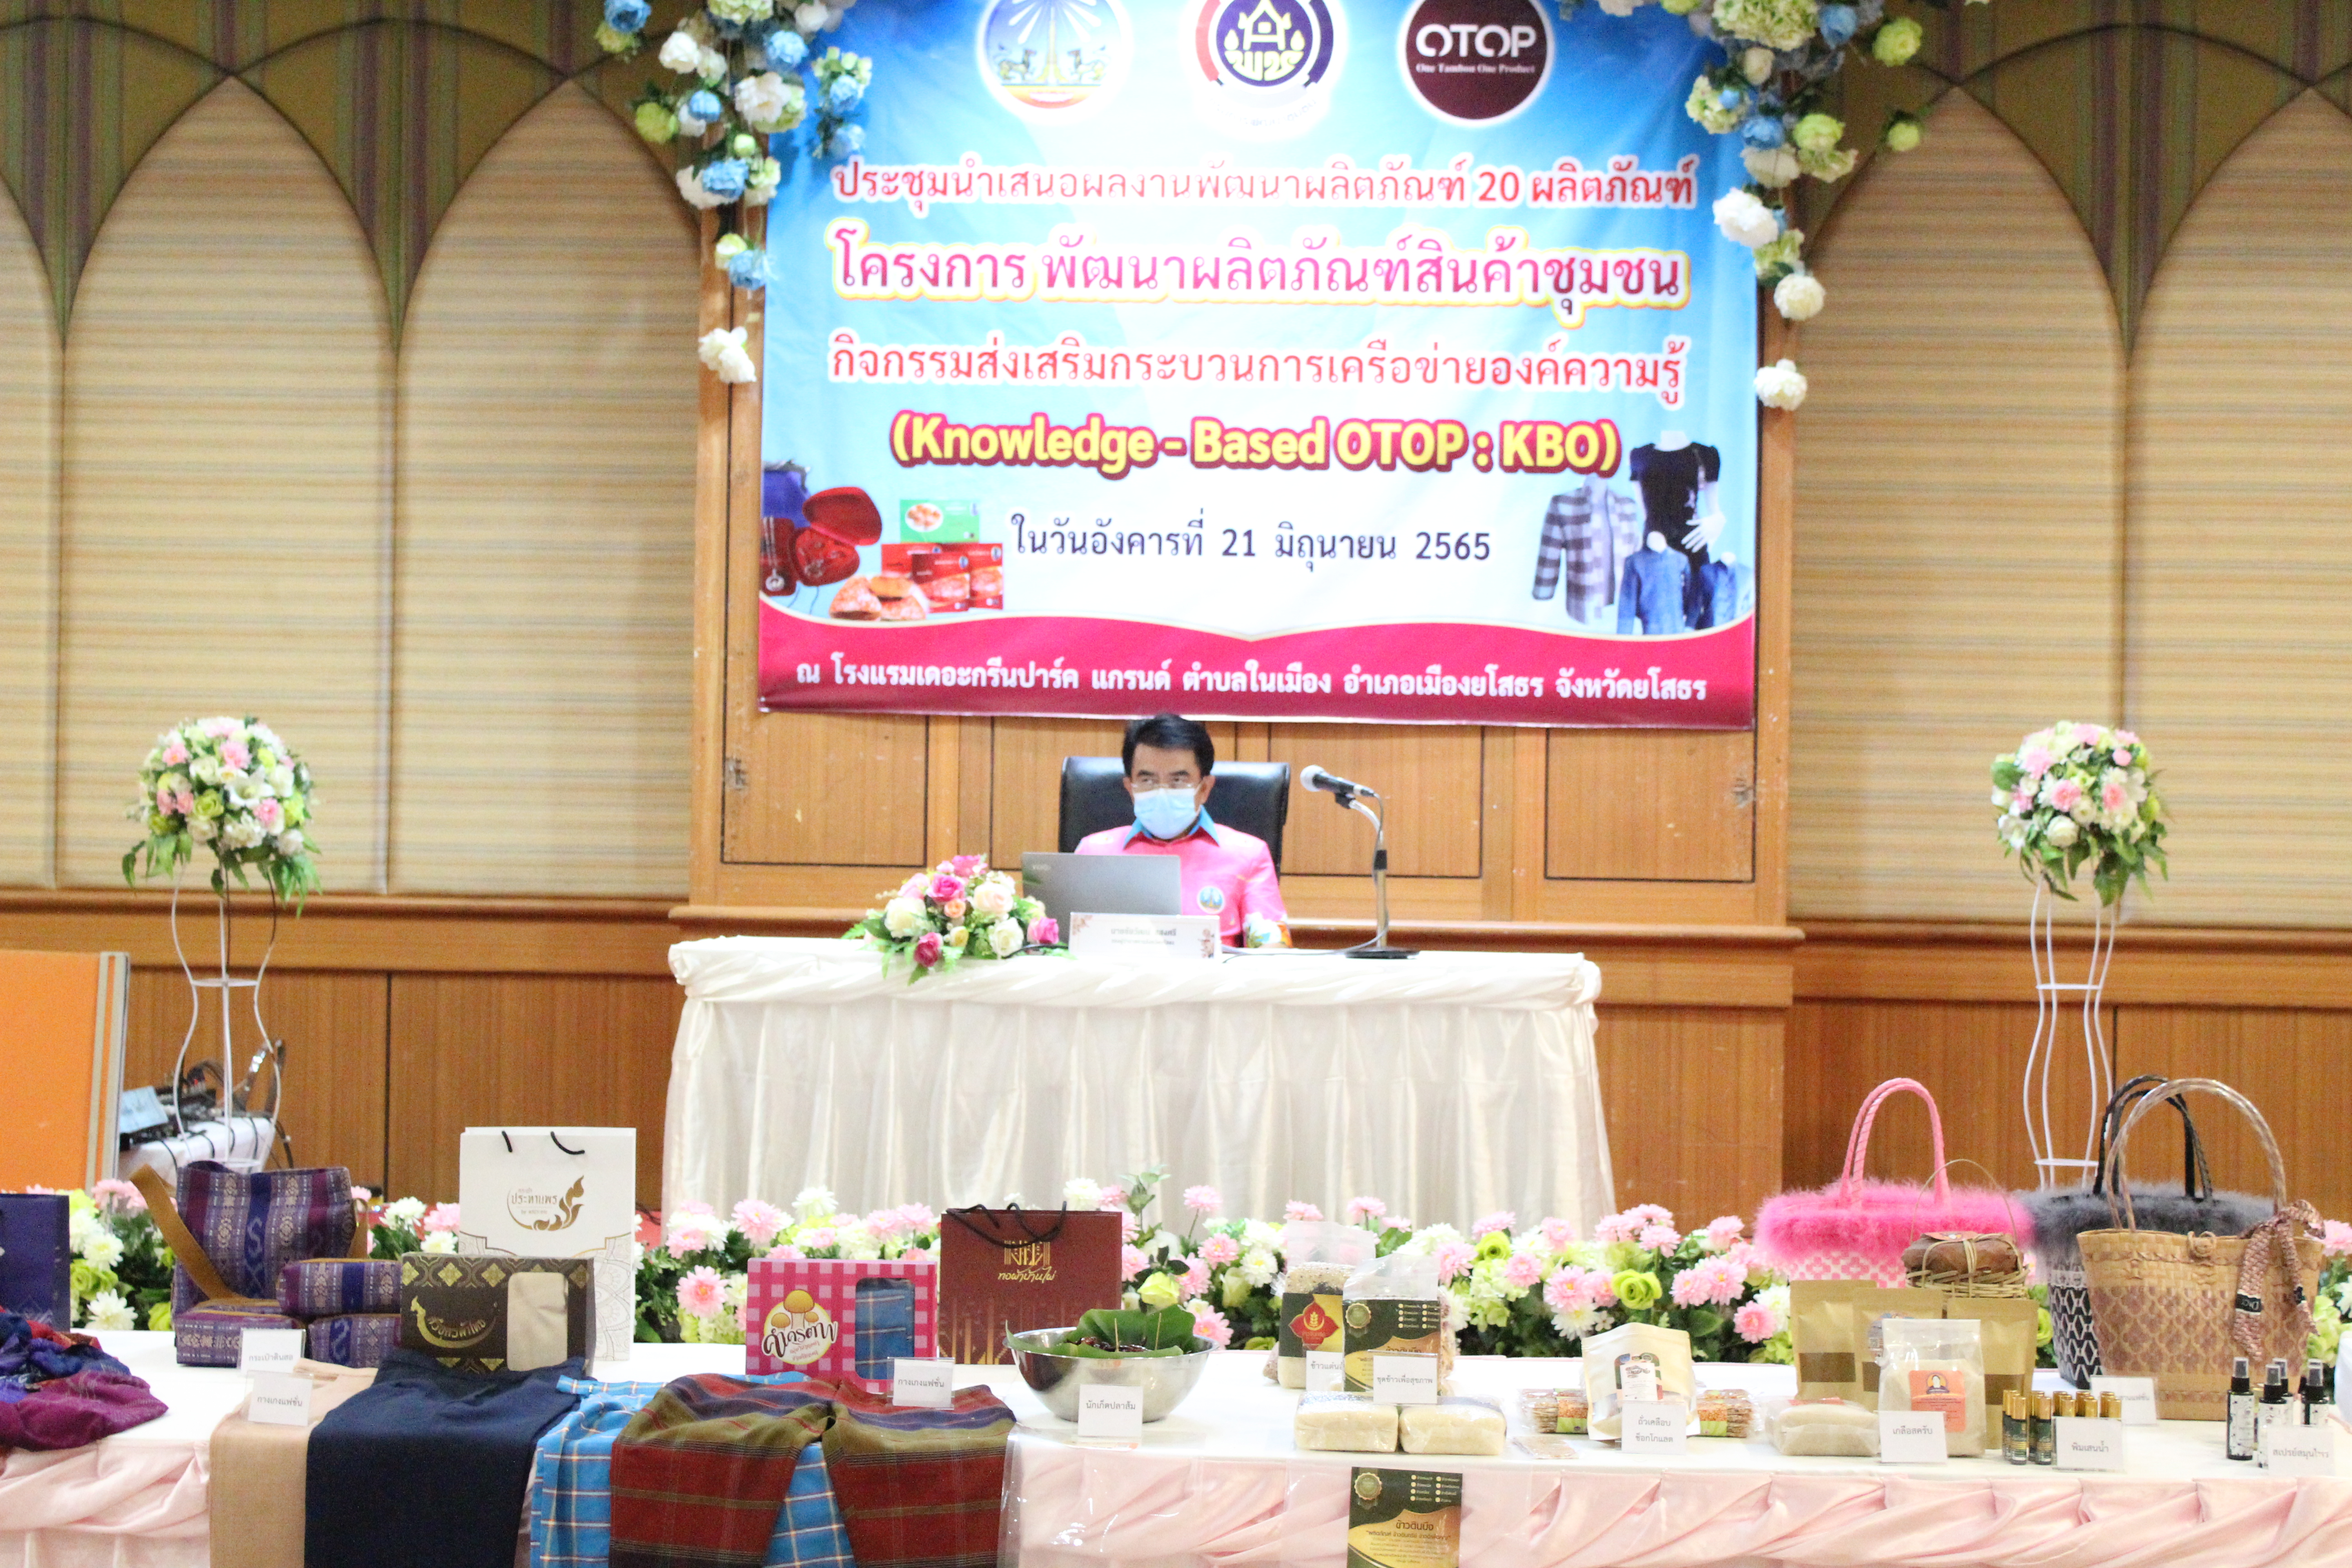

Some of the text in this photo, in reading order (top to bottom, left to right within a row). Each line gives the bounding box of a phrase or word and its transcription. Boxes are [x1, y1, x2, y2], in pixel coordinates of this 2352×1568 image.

[1416, 23, 1537, 58] OTOP
[1416, 63, 1436, 73] One
[1477, 64, 1496, 74] One
[1499, 64, 1536, 74] Product
[835, 158, 1695, 212] ประชุมนำเสนอผลงานพัฒนาผลิตภัณฑ์ 20 ผลิตภัณฑ์
[834, 228, 1681, 315] โครงการ พัฒนาผลิตภัณฑ์สินค้าชุมชน
[833, 333, 1686, 405] กิจกรรมส่งเสริมกระบวนการเครือข่ายองค์ความรู้
[891, 411, 1156, 477] (Knowledge
[1192, 417, 1328, 467] Based
[1335, 420, 1467, 469] OTOP
[1501, 421, 1620, 474] KBO)
[1010, 508, 1490, 572] ในวันอังคารที่ 21 มิถุนายน 2565
[797, 652, 1706, 700] ณ โรงแรมเดอะกรีนปาร์ค แกรนด์ ตำบลในเมือง อำเภอเมืองยโสธร จังหวัดยโสธร
[898, 1377, 945, 1387] กางเกงแฟชั่น
[1638, 1415, 1671, 1426] ถั่วเคลือบ
[1892, 1425, 1933, 1435] เกลือสครับ
[2072, 1440, 2109, 1452] พิมเสนน้ำ
